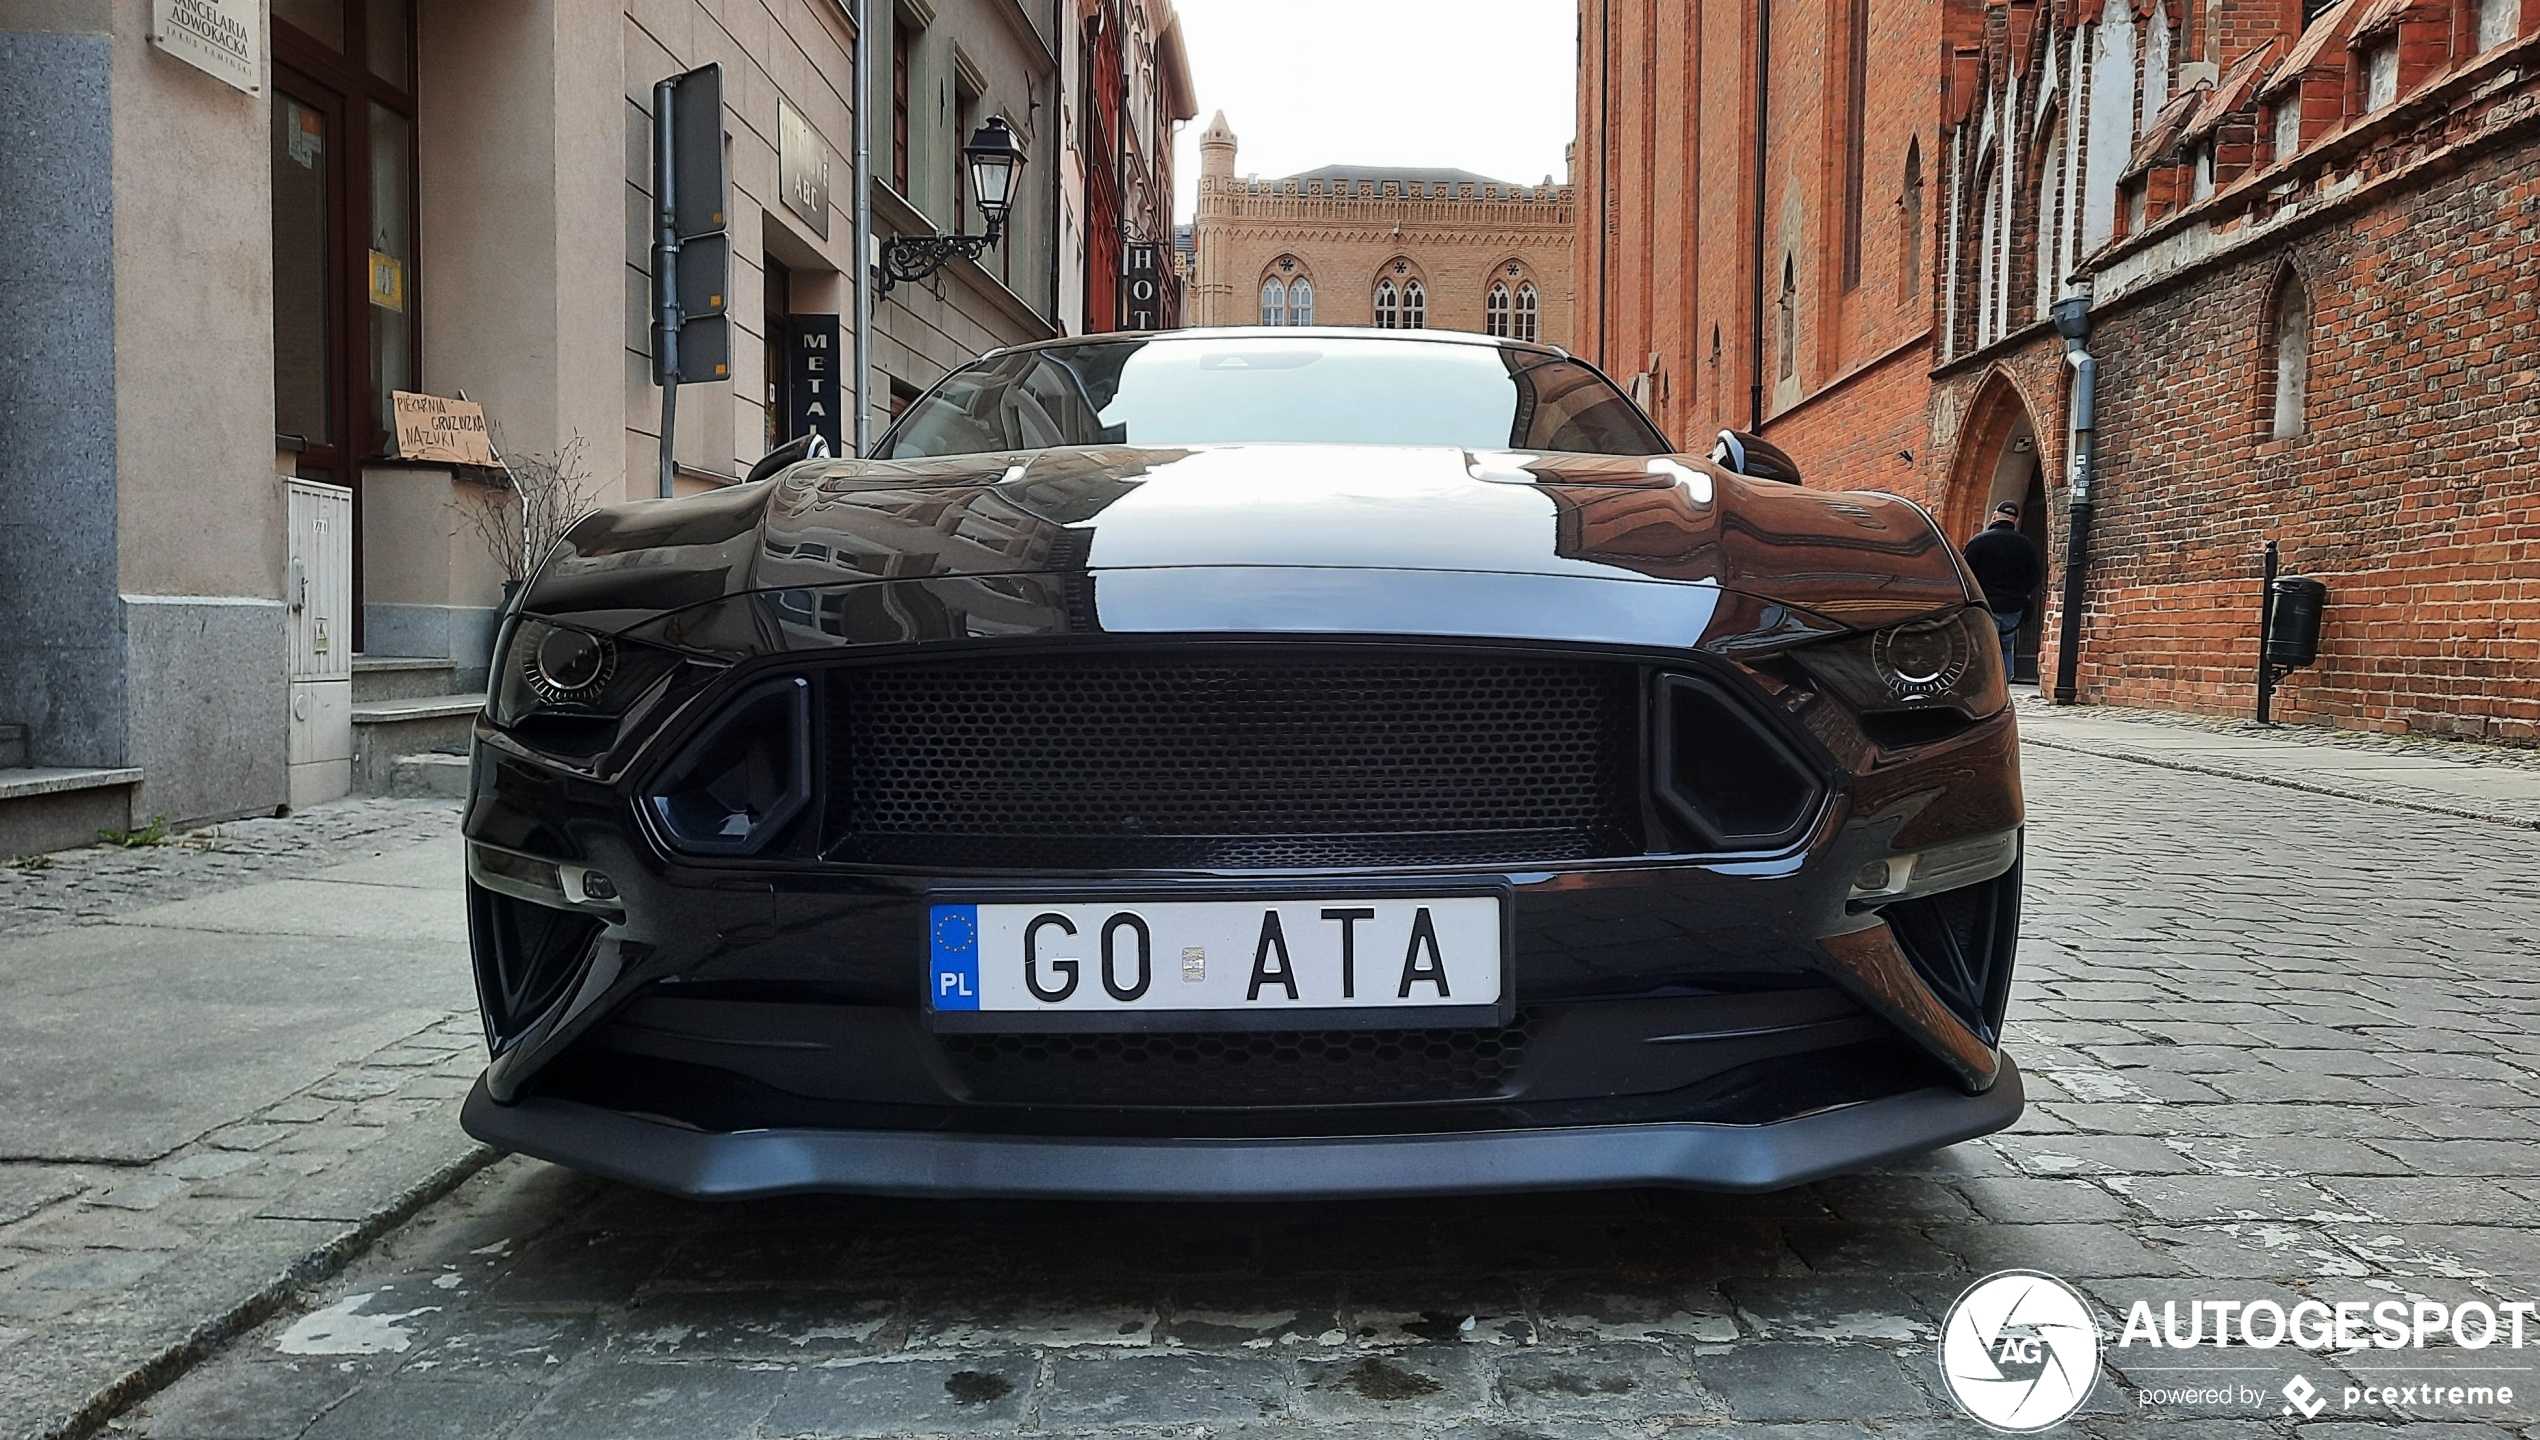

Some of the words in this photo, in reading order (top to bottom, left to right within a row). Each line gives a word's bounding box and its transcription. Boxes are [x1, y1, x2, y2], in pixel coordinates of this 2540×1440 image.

[172, 6, 248, 58] ADWOKACKA
[174, 0, 248, 42] ANCELARIA
[794, 172, 818, 213] ABC
[1133, 249, 1153, 330] HOT
[397, 396, 446, 414] PIEKARNIA
[940, 972, 972, 996] PL
[1245, 905, 1451, 1001] ATA
